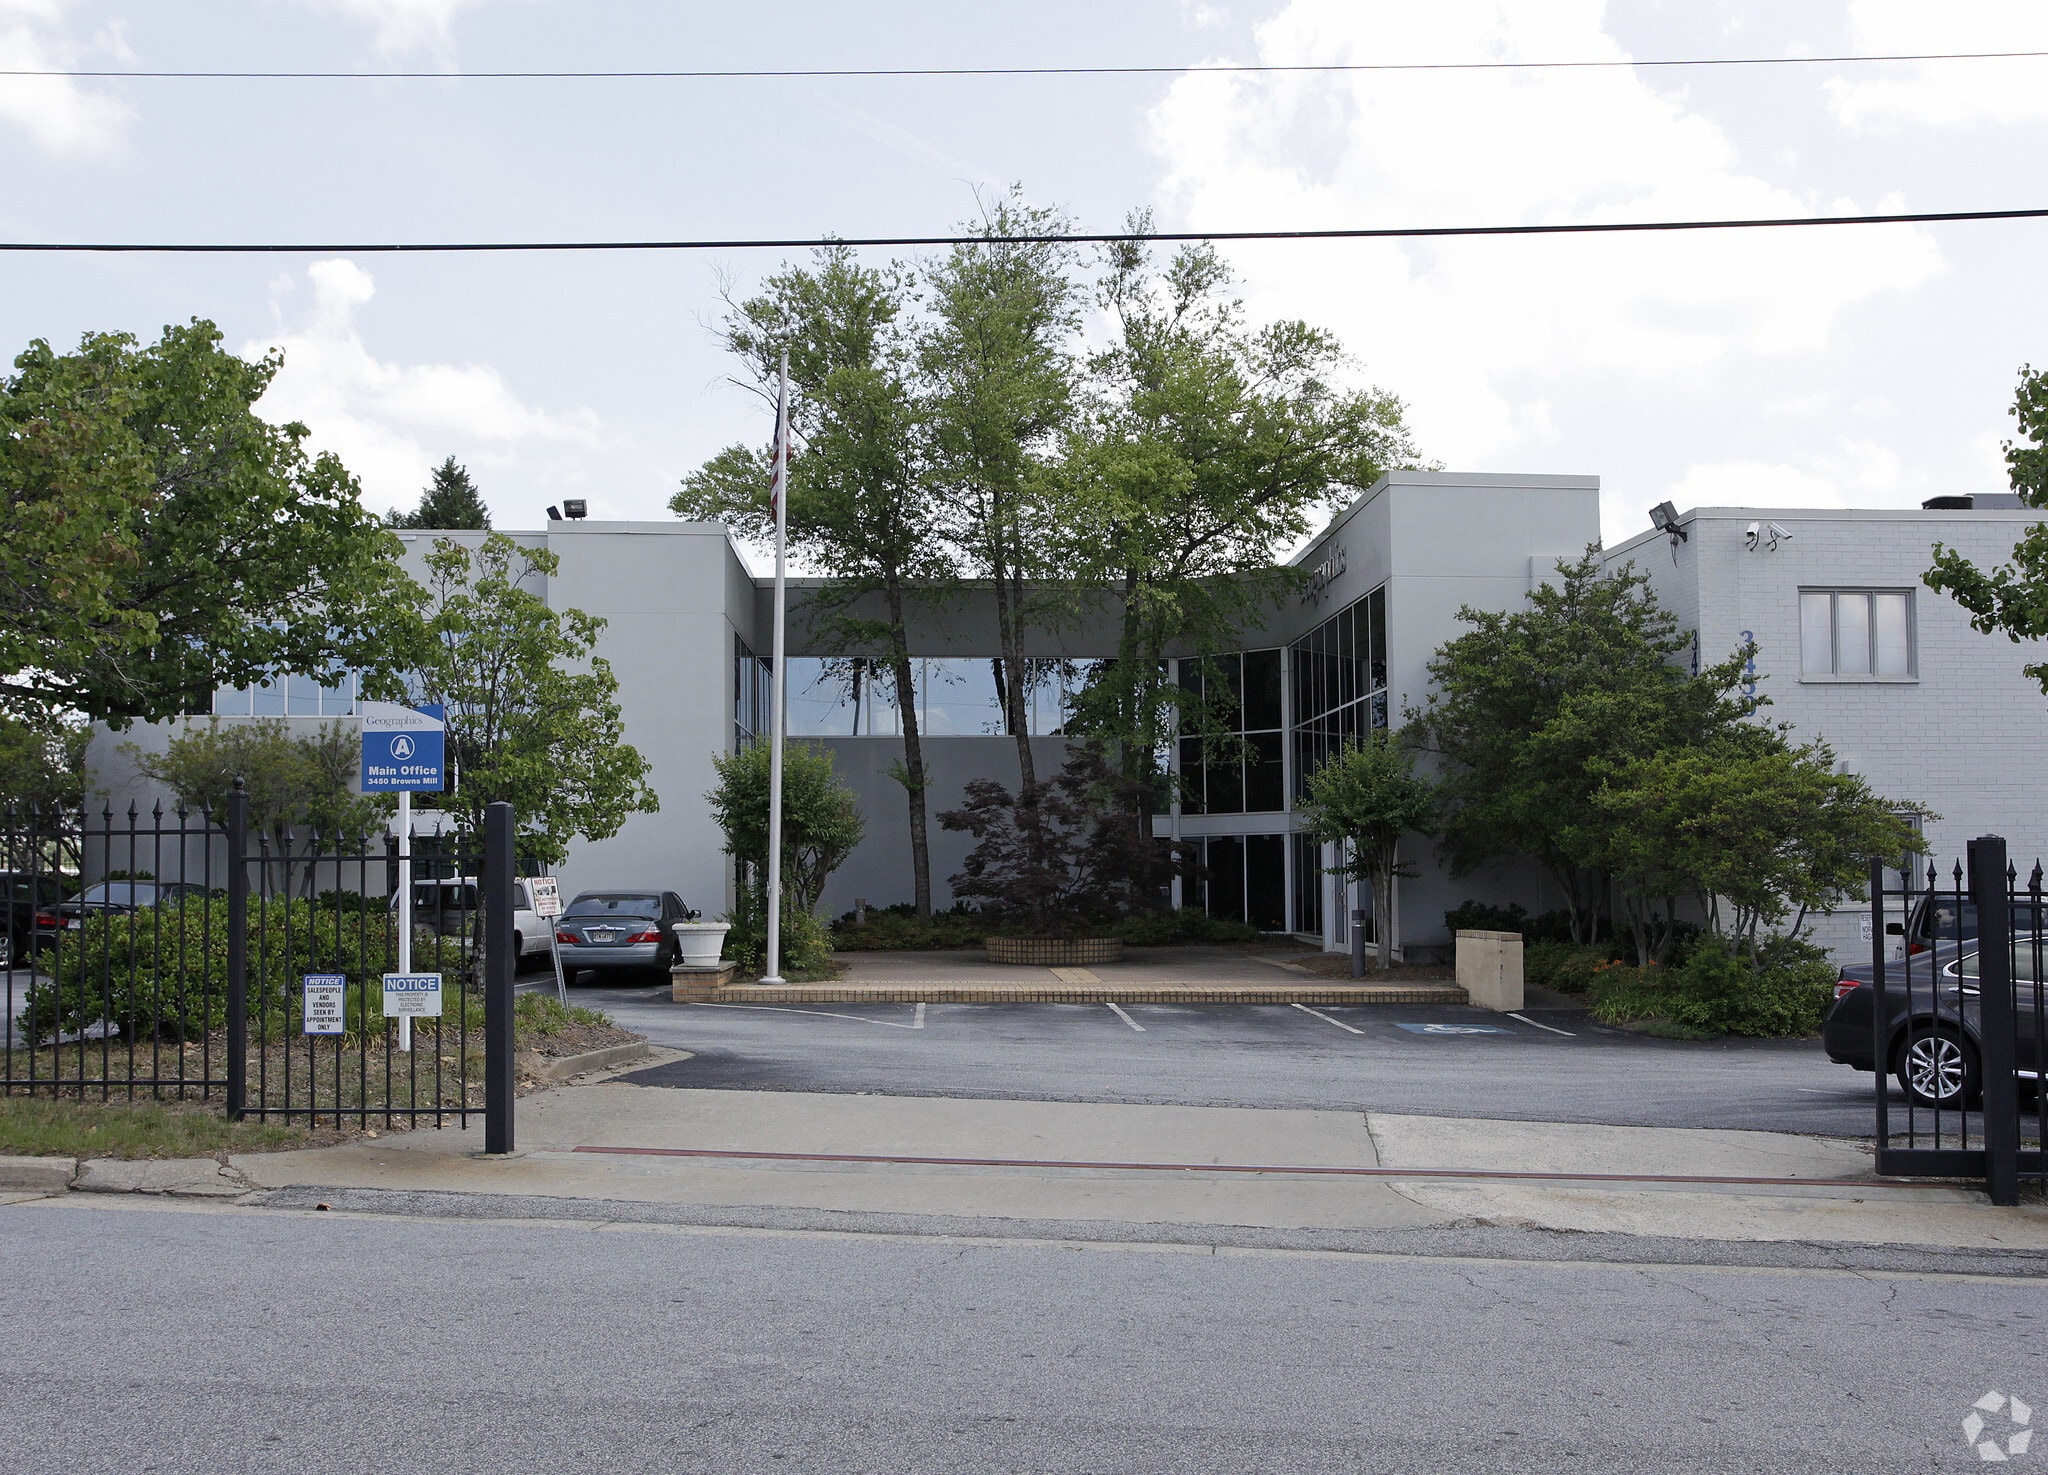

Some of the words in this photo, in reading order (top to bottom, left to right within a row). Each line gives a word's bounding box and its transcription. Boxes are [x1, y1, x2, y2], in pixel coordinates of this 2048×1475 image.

[366, 715, 423, 728] Geographics
[394, 738, 411, 755] A
[368, 765, 397, 776] Main
[400, 765, 438, 775] Office
[386, 979, 436, 991] NOTICE
